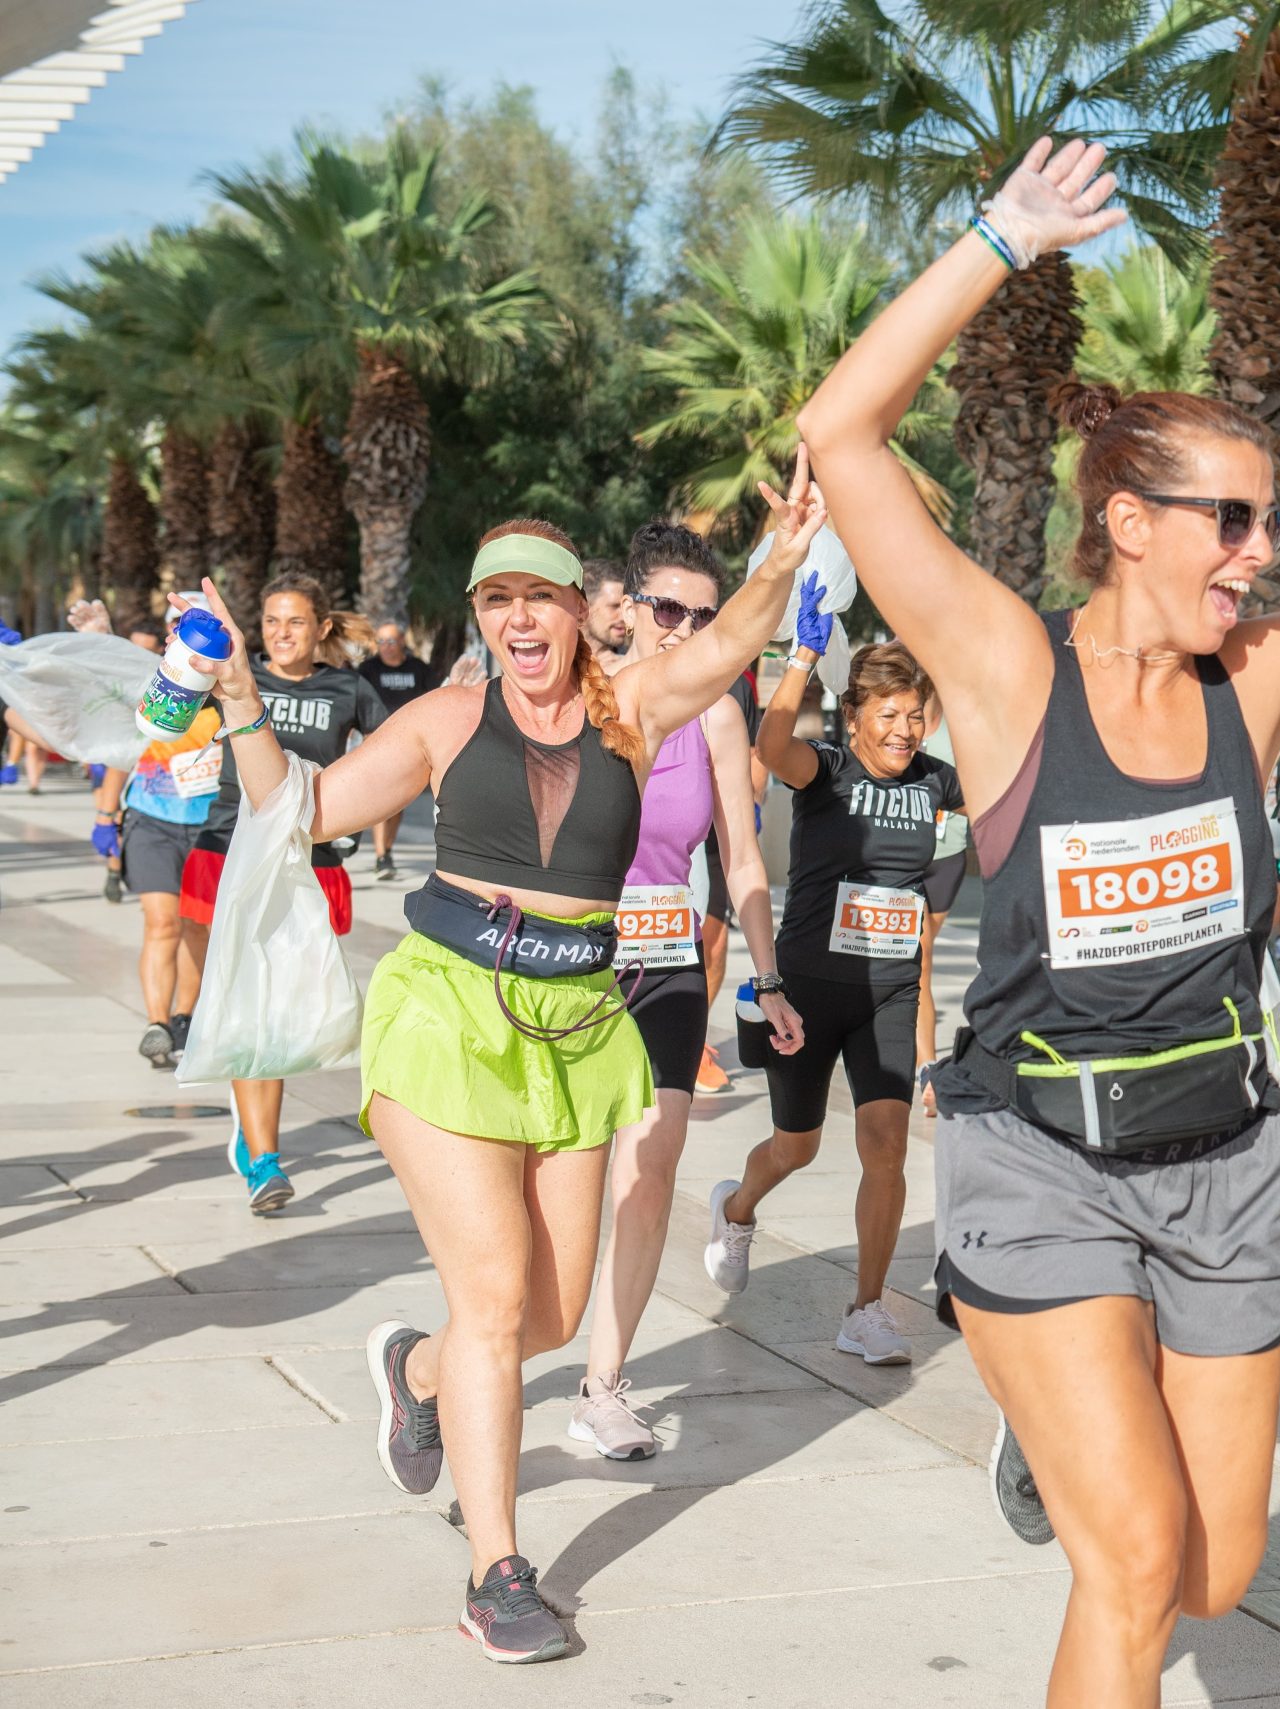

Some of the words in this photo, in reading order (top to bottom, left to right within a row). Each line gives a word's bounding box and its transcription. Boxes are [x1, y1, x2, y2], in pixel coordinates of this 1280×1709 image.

[261, 696, 331, 731] TCLUB
[270, 722, 304, 734] LAGA
[849, 785, 933, 824] FITCLUB
[875, 818, 917, 831] MALAGA
[1090, 838, 1127, 847] nationale
[1091, 845, 1140, 855] nederlanden
[1071, 854, 1220, 911] 18098
[849, 908, 912, 932] 19393
[1077, 923, 1222, 960] #HAZDEPORTEPORELPLANETA
